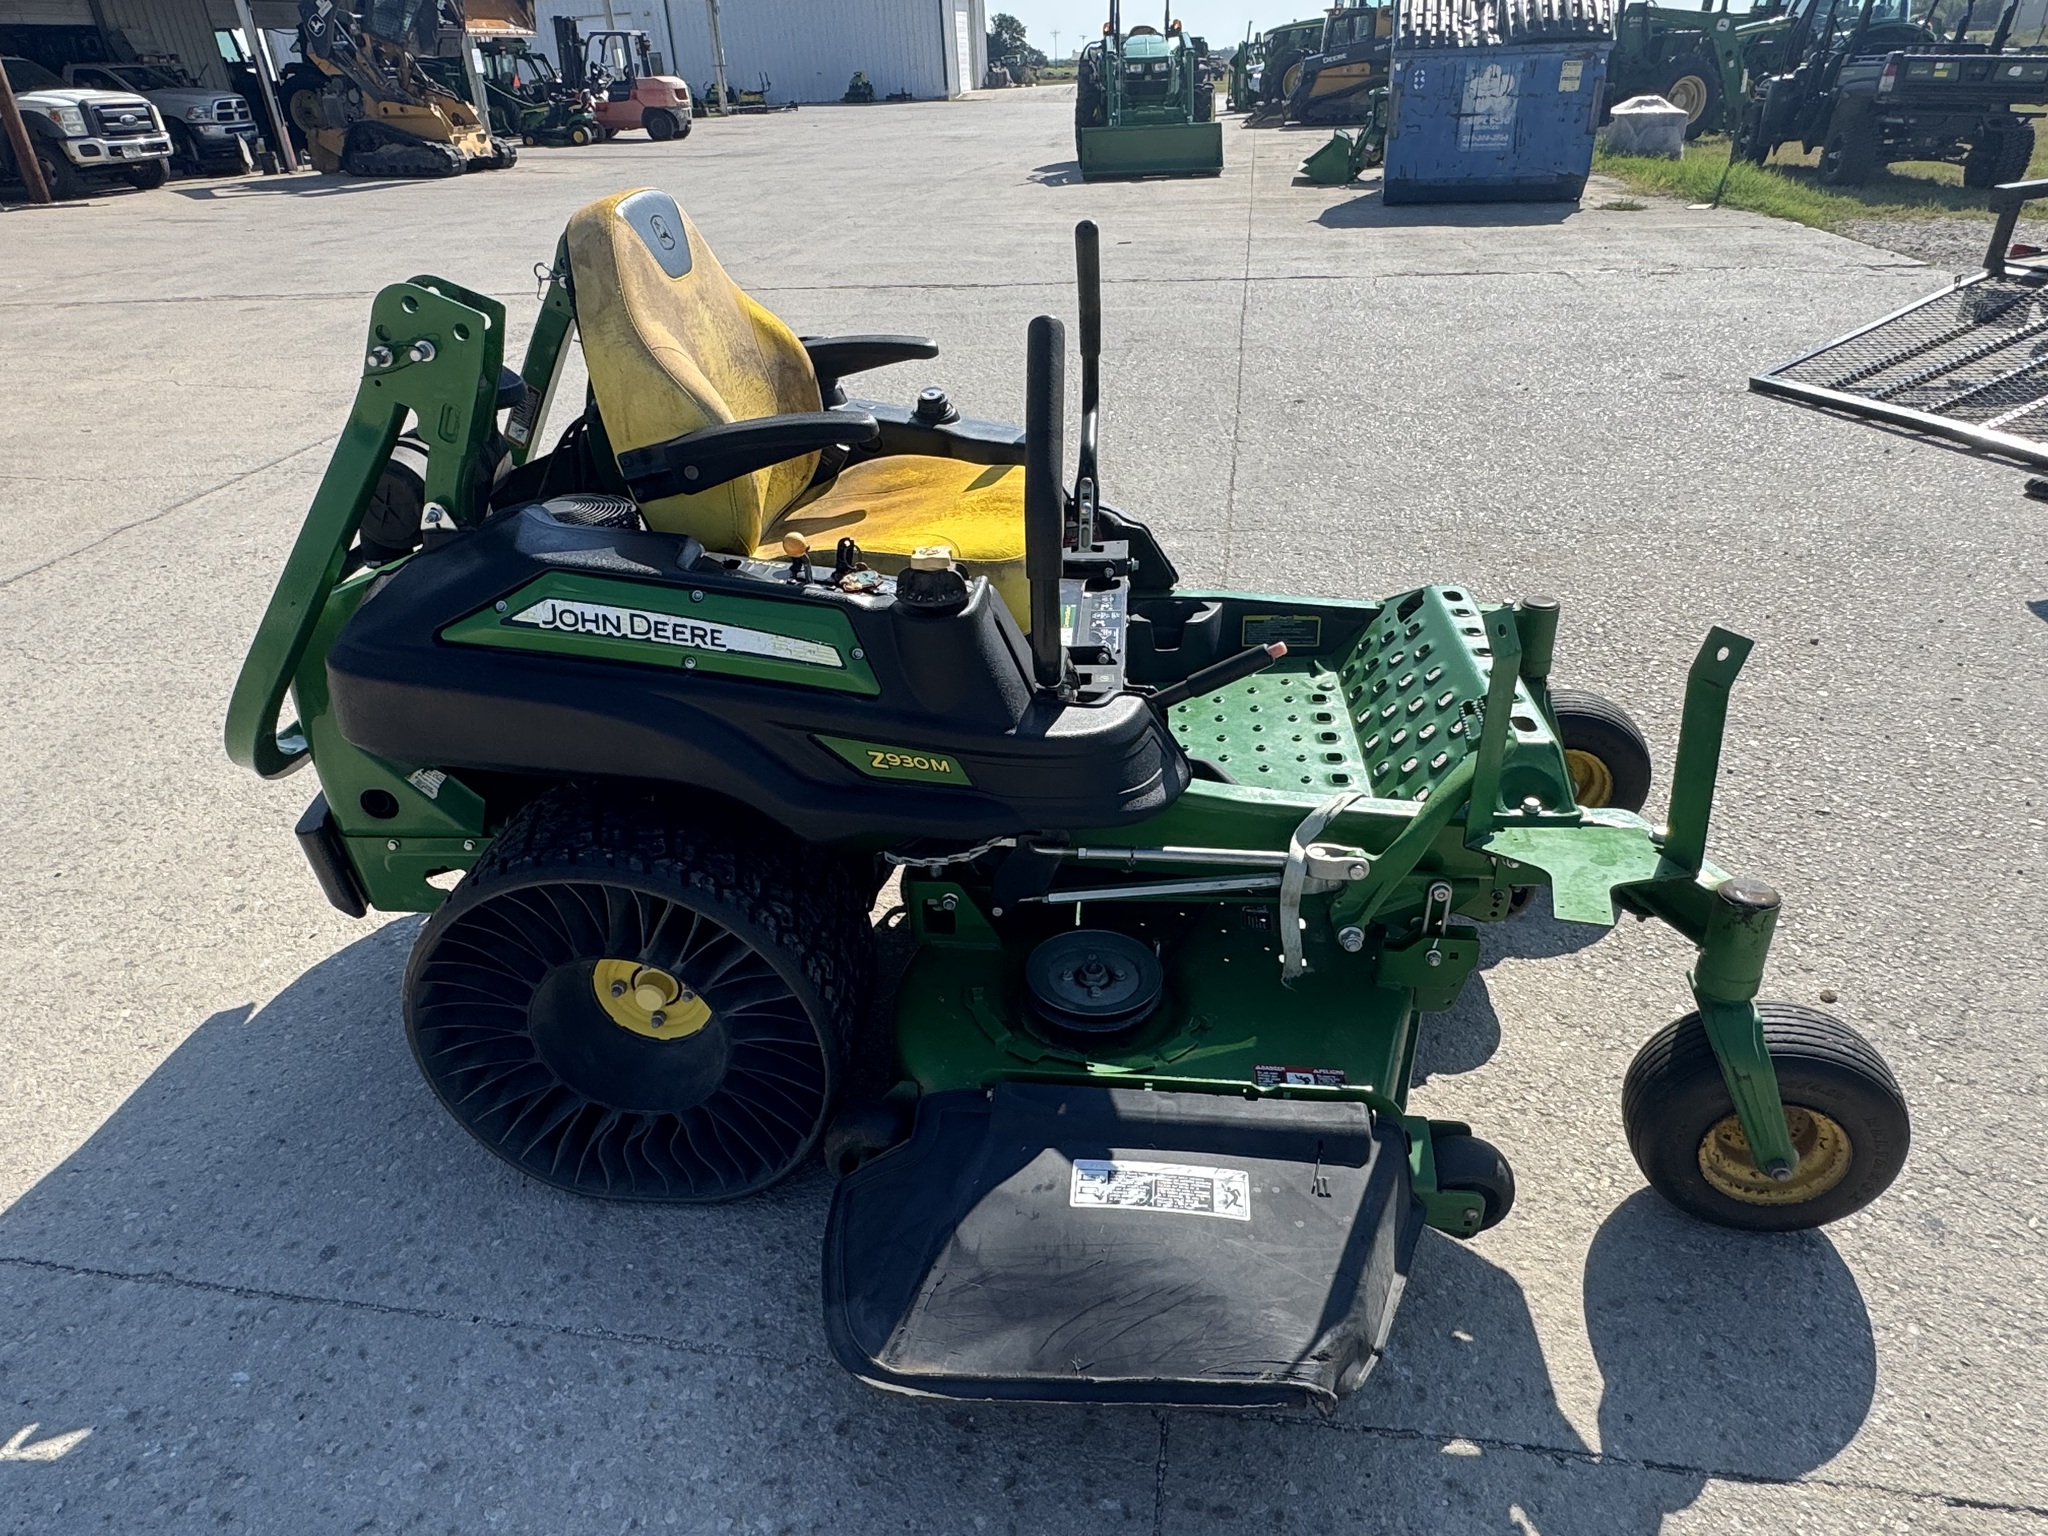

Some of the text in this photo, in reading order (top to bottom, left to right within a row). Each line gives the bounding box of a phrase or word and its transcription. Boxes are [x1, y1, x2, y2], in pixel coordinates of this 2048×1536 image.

[1322, 53, 1347, 64] DEERE
[542, 603, 727, 649] JOHN DEERE
[867, 750, 951, 773] Z930M
